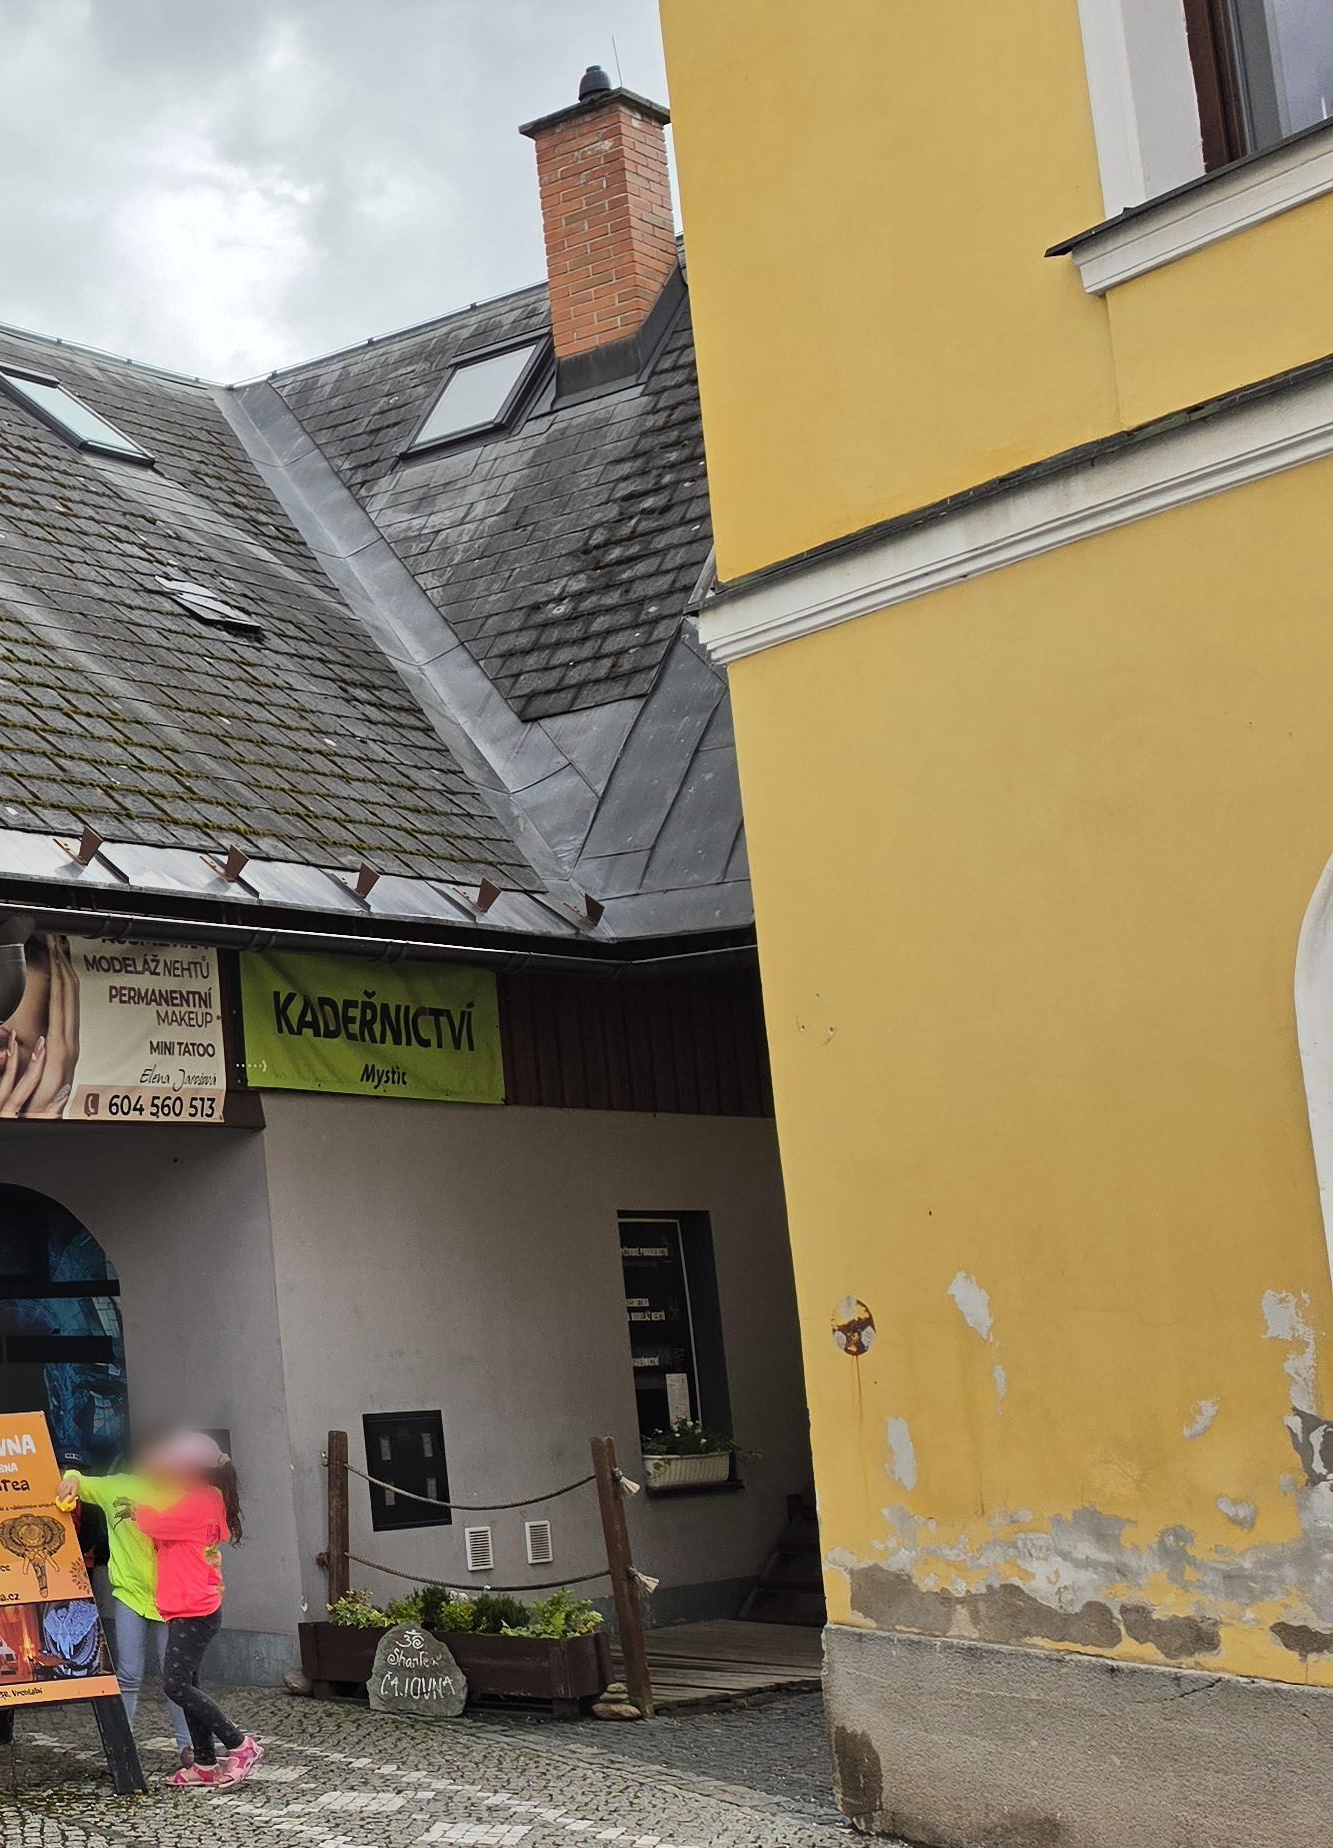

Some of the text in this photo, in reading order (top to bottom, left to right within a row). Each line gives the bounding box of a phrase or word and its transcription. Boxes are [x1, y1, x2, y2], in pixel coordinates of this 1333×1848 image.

[83, 954, 210, 979] MODELÁŽ NEHTŮ
[109, 985, 213, 1009] PERMANENTNÍ
[156, 1009, 213, 1028] MAKEUP
[273, 989, 475, 1051] KADEŘNICTVÍ
[149, 1040, 215, 1057] MINI TATOO
[140, 1064, 170, 1084] Elena
[360, 1063, 407, 1089] Mystic
[109, 1093, 216, 1118] 604 560 513
[381, 1671, 456, 1700] ČAJOVNA
